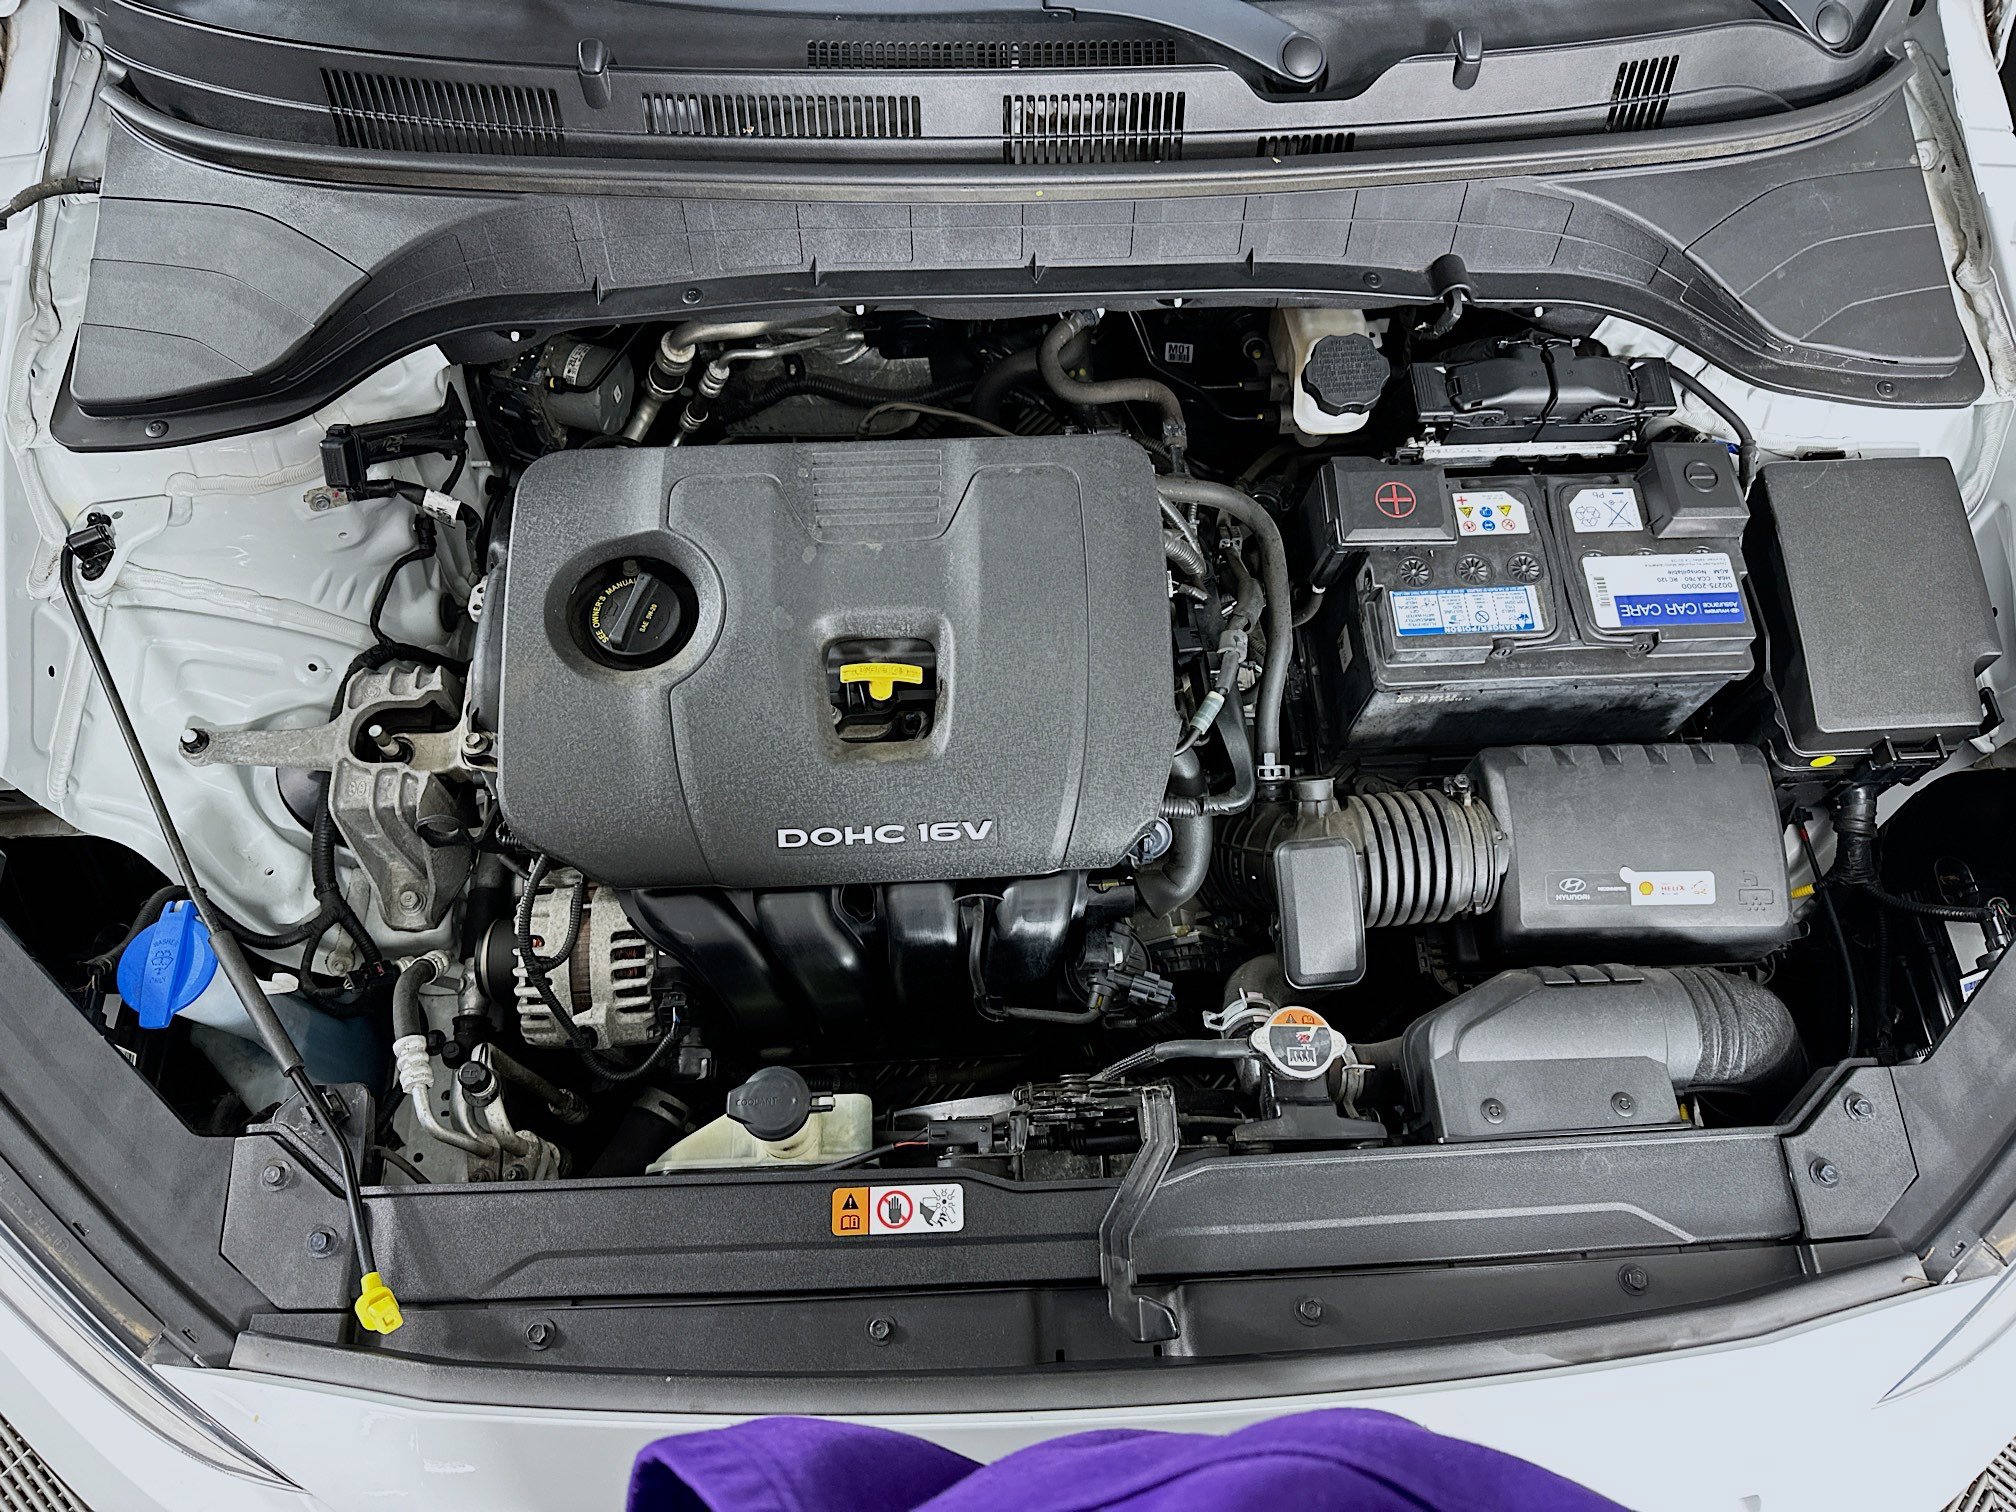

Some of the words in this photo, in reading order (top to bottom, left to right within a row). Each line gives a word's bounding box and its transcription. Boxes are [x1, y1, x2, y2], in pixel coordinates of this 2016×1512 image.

[1681, 582, 1733, 590] 00275-20000
[591, 595, 607, 629] OWNER'S
[1619, 604, 1662, 617] CARE
[1666, 602, 1698, 616] CAR
[639, 620, 650, 633] SAE
[595, 628, 609, 643] SEE
[777, 824, 906, 848] DOHC
[918, 820, 993, 842] 16V
[735, 1097, 777, 1106] COOLANT
